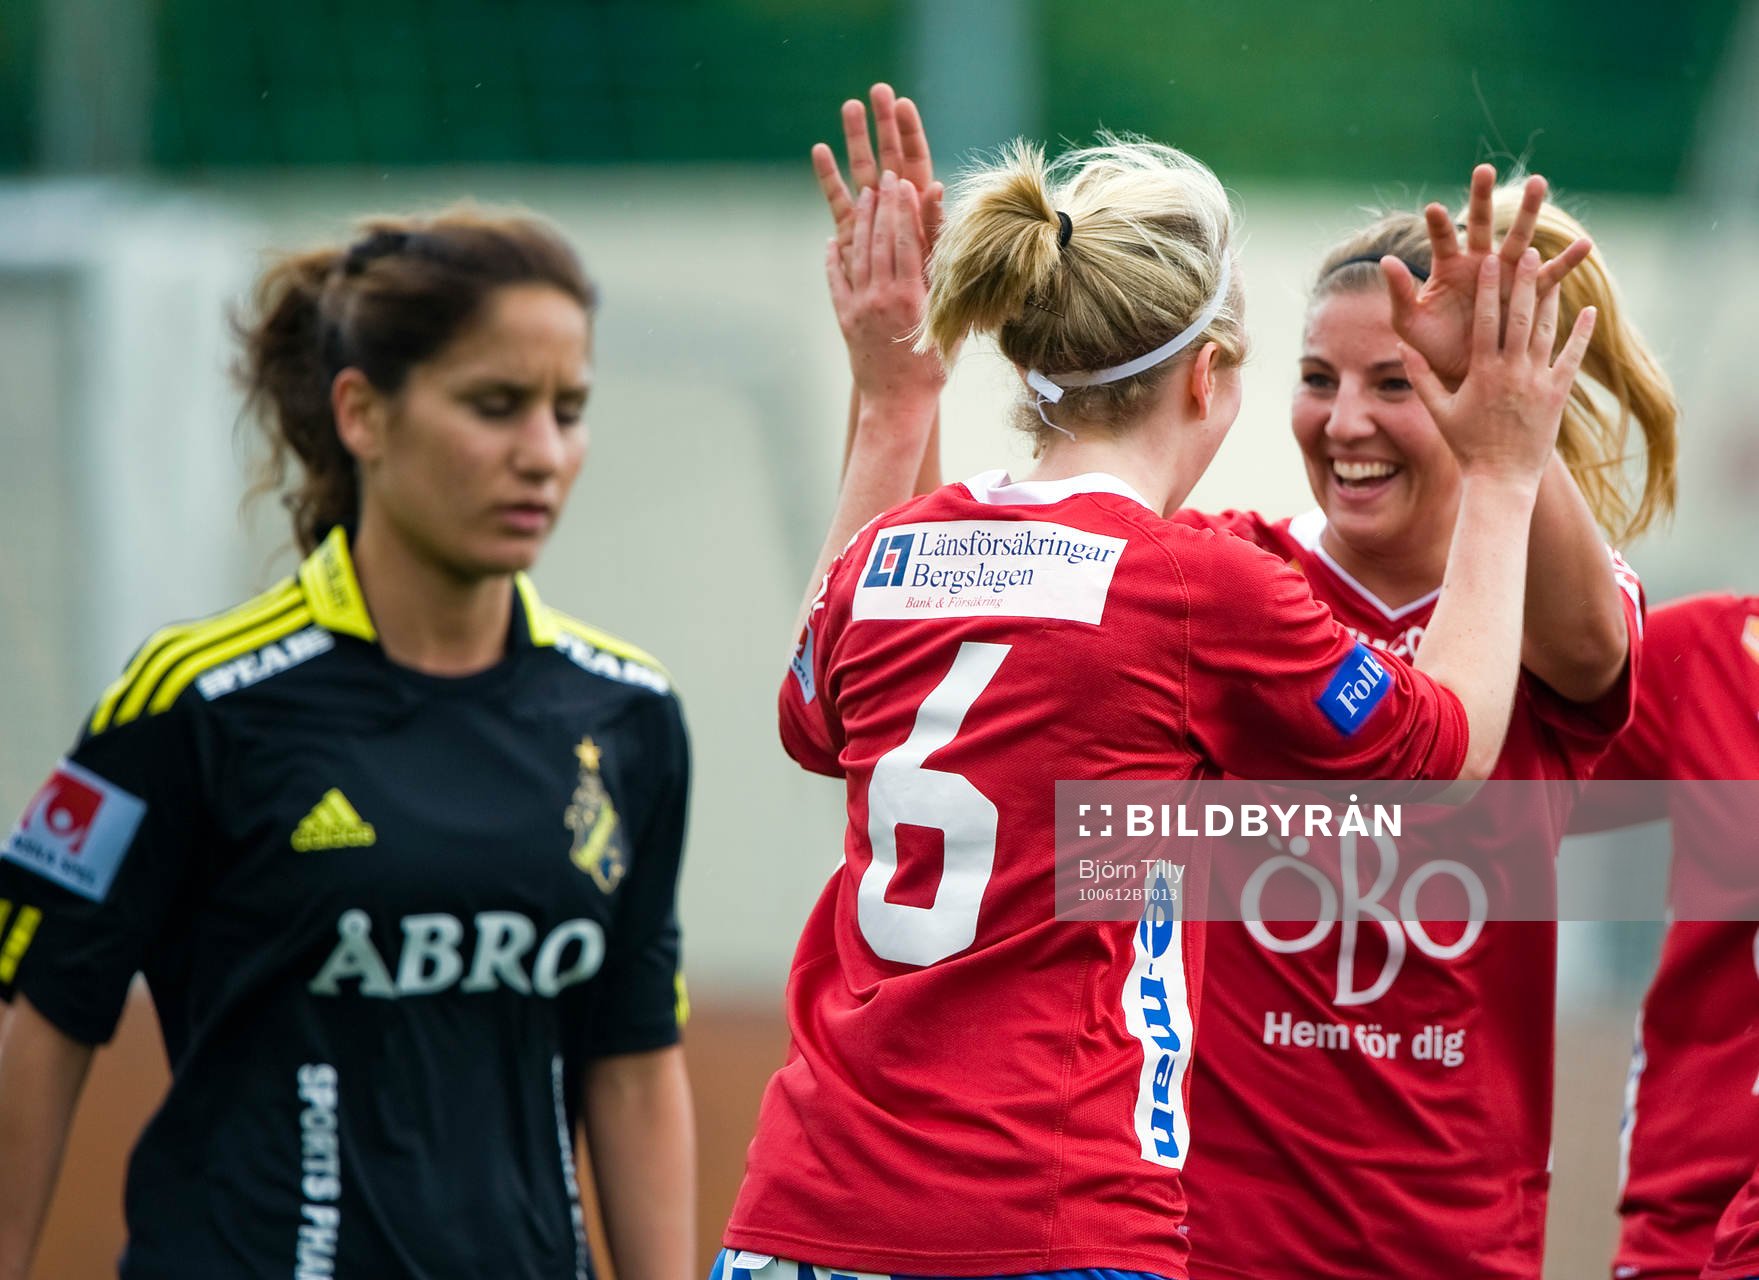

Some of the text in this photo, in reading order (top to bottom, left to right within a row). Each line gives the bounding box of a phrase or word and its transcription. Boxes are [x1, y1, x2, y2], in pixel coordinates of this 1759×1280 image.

[911, 563, 1034, 594] Bergslagen
[918, 530, 1116, 564] Länsförsäkringar
[905, 596, 1003, 608] Bank & Försäkring
[858, 641, 1013, 966] 6
[1240, 814, 1488, 1006] ÖBO
[307, 908, 606, 999] ÅBRO
[1263, 1011, 1466, 1067] Hem för dig
[297, 1063, 341, 1200] SPORTS
